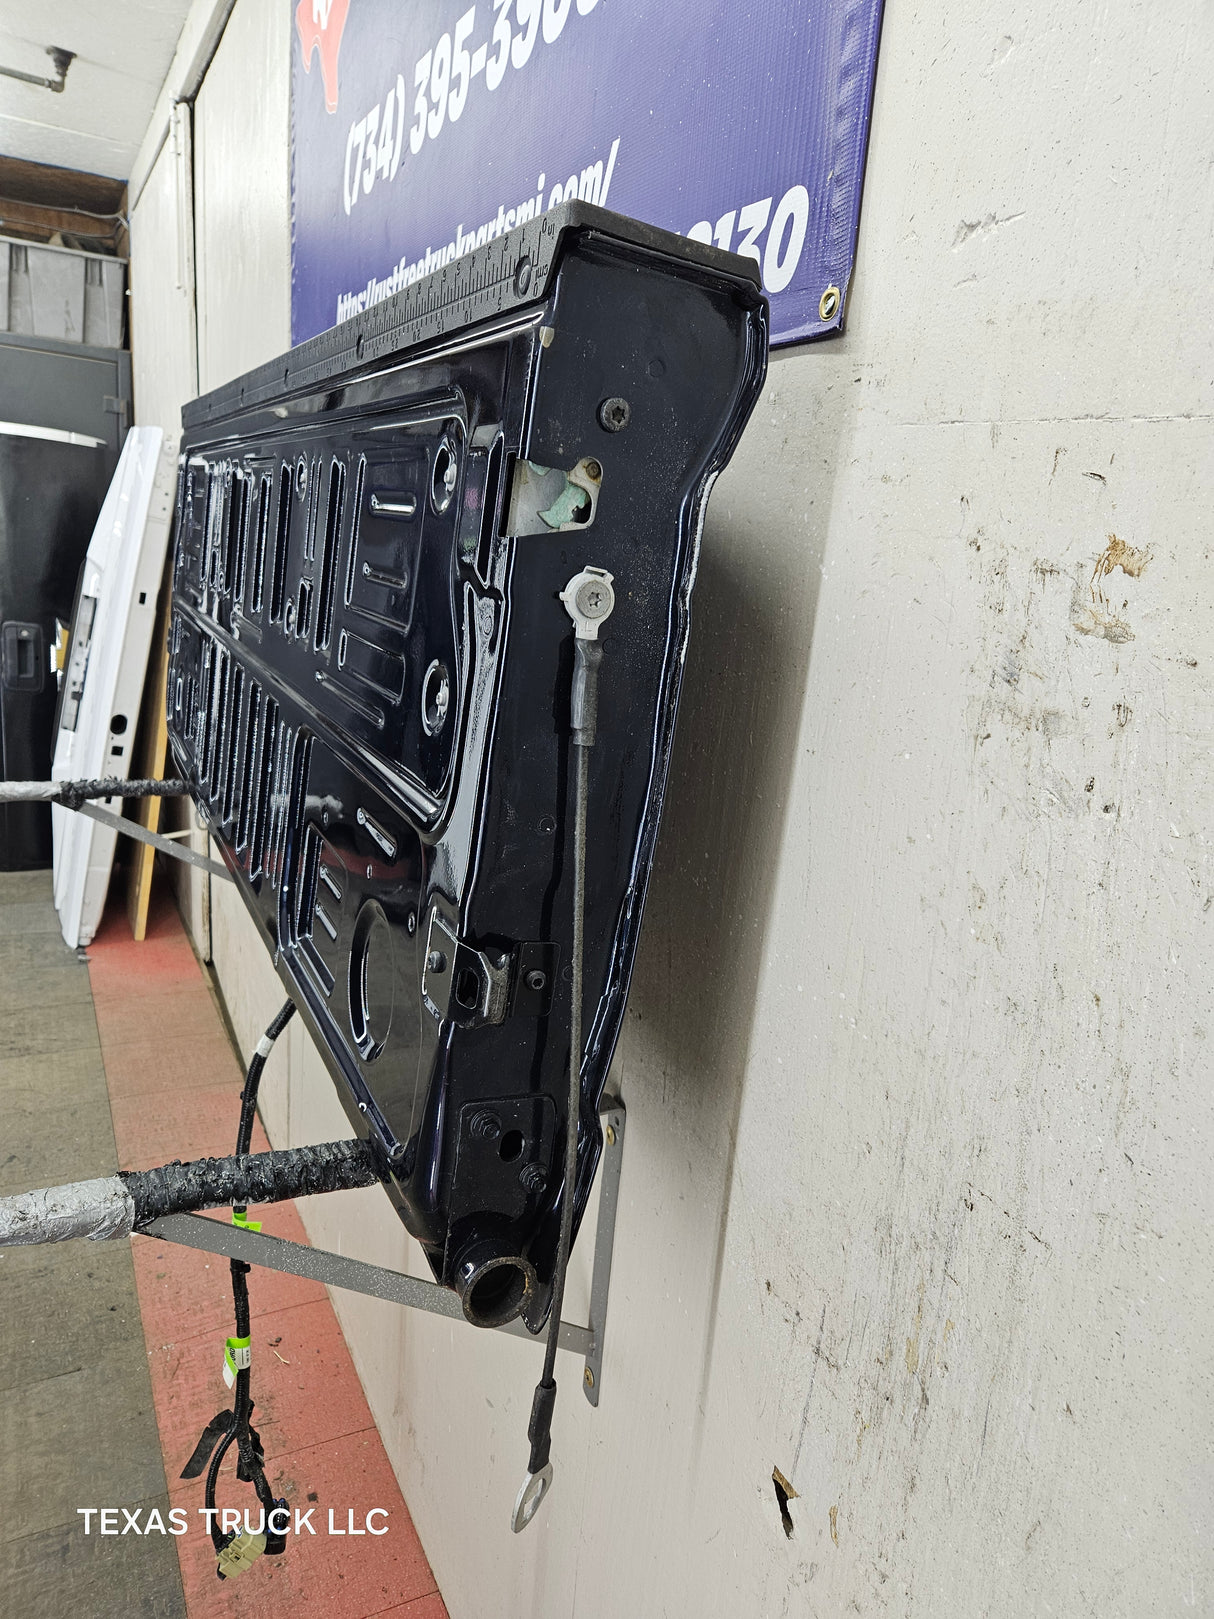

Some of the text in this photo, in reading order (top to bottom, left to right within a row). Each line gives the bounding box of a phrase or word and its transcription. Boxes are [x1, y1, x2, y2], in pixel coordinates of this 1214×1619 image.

[344, 0, 599, 215] (734) 395-39
[503, 233, 509, 252] 2
[521, 228, 526, 243] 1
[487, 245, 492, 261] 3
[497, 297, 502, 311] 5
[464, 309, 472, 323] 10
